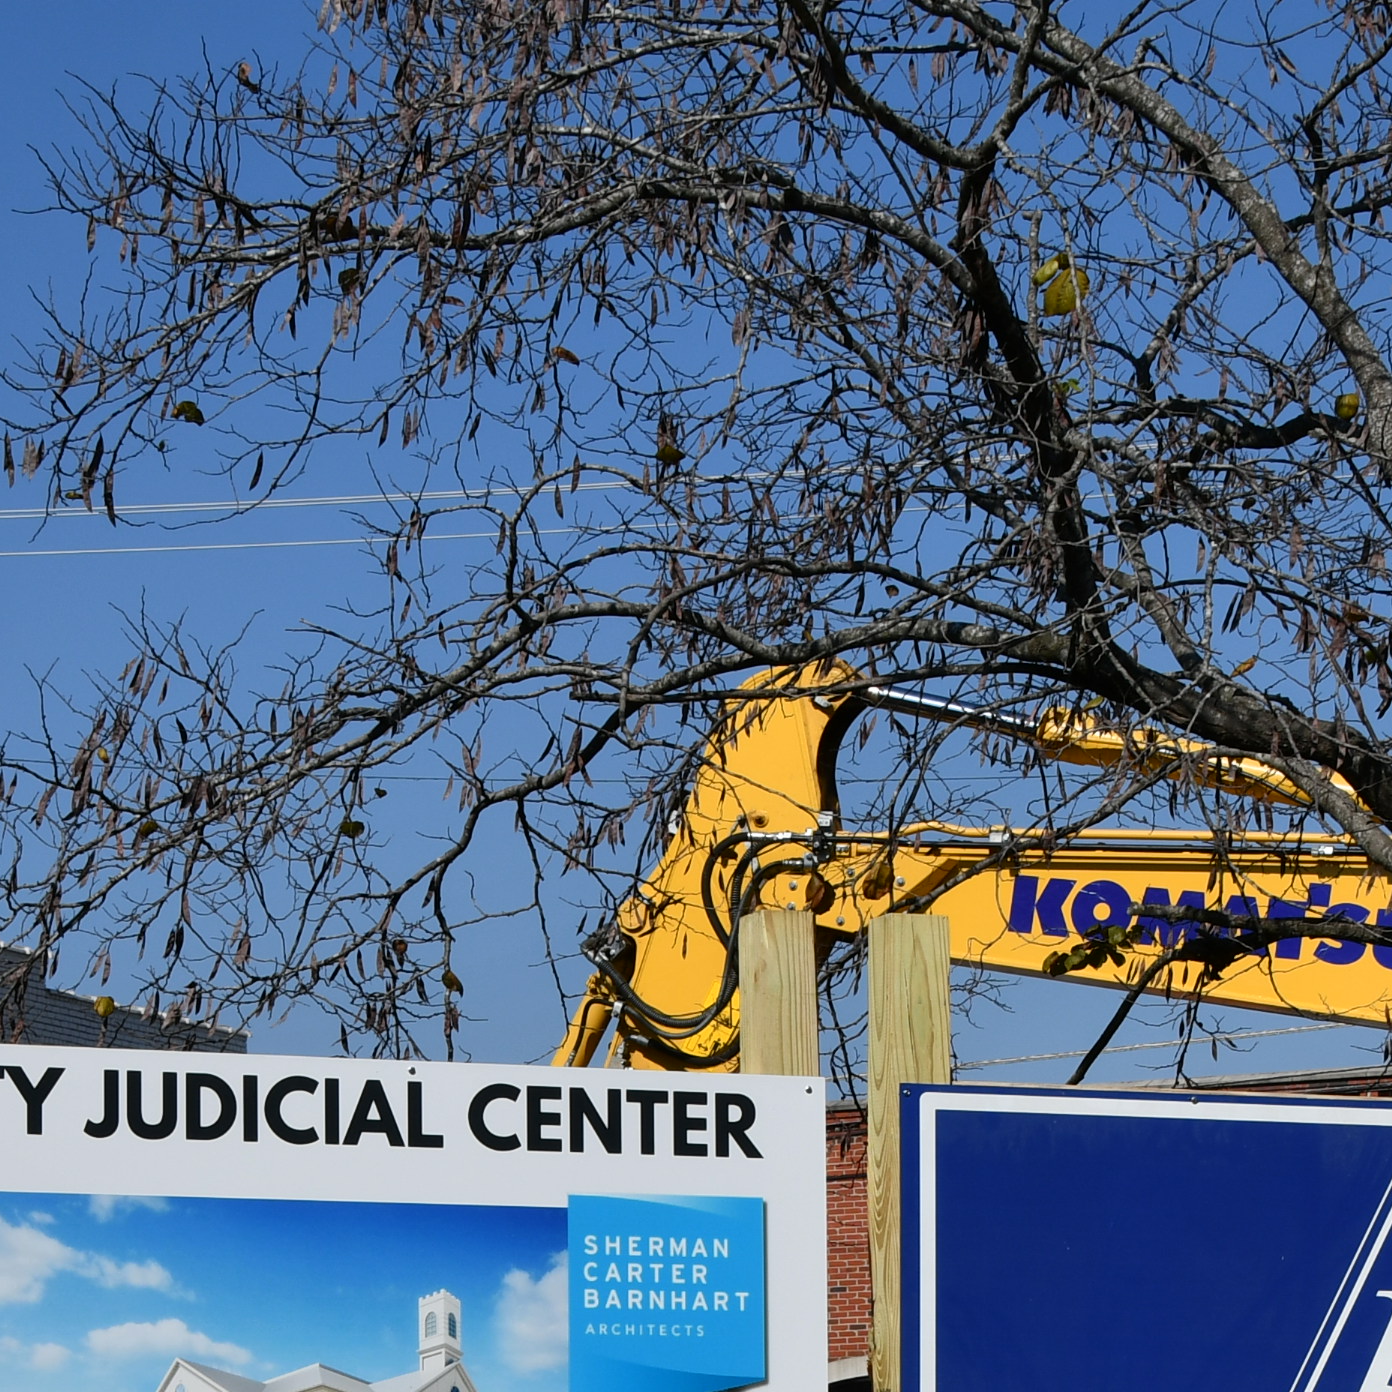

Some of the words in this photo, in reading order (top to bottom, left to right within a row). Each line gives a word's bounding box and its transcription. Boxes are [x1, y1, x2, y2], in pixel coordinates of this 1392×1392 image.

[82, 1068, 444, 1149] JUDICIAL
[467, 1082, 764, 1159] CENTER
[583, 1234, 728, 1258] SHERMAN
[583, 1261, 707, 1285] CARTER
[583, 1288, 750, 1312] BARNHART
[584, 1322, 704, 1337] ARCHITECTS
